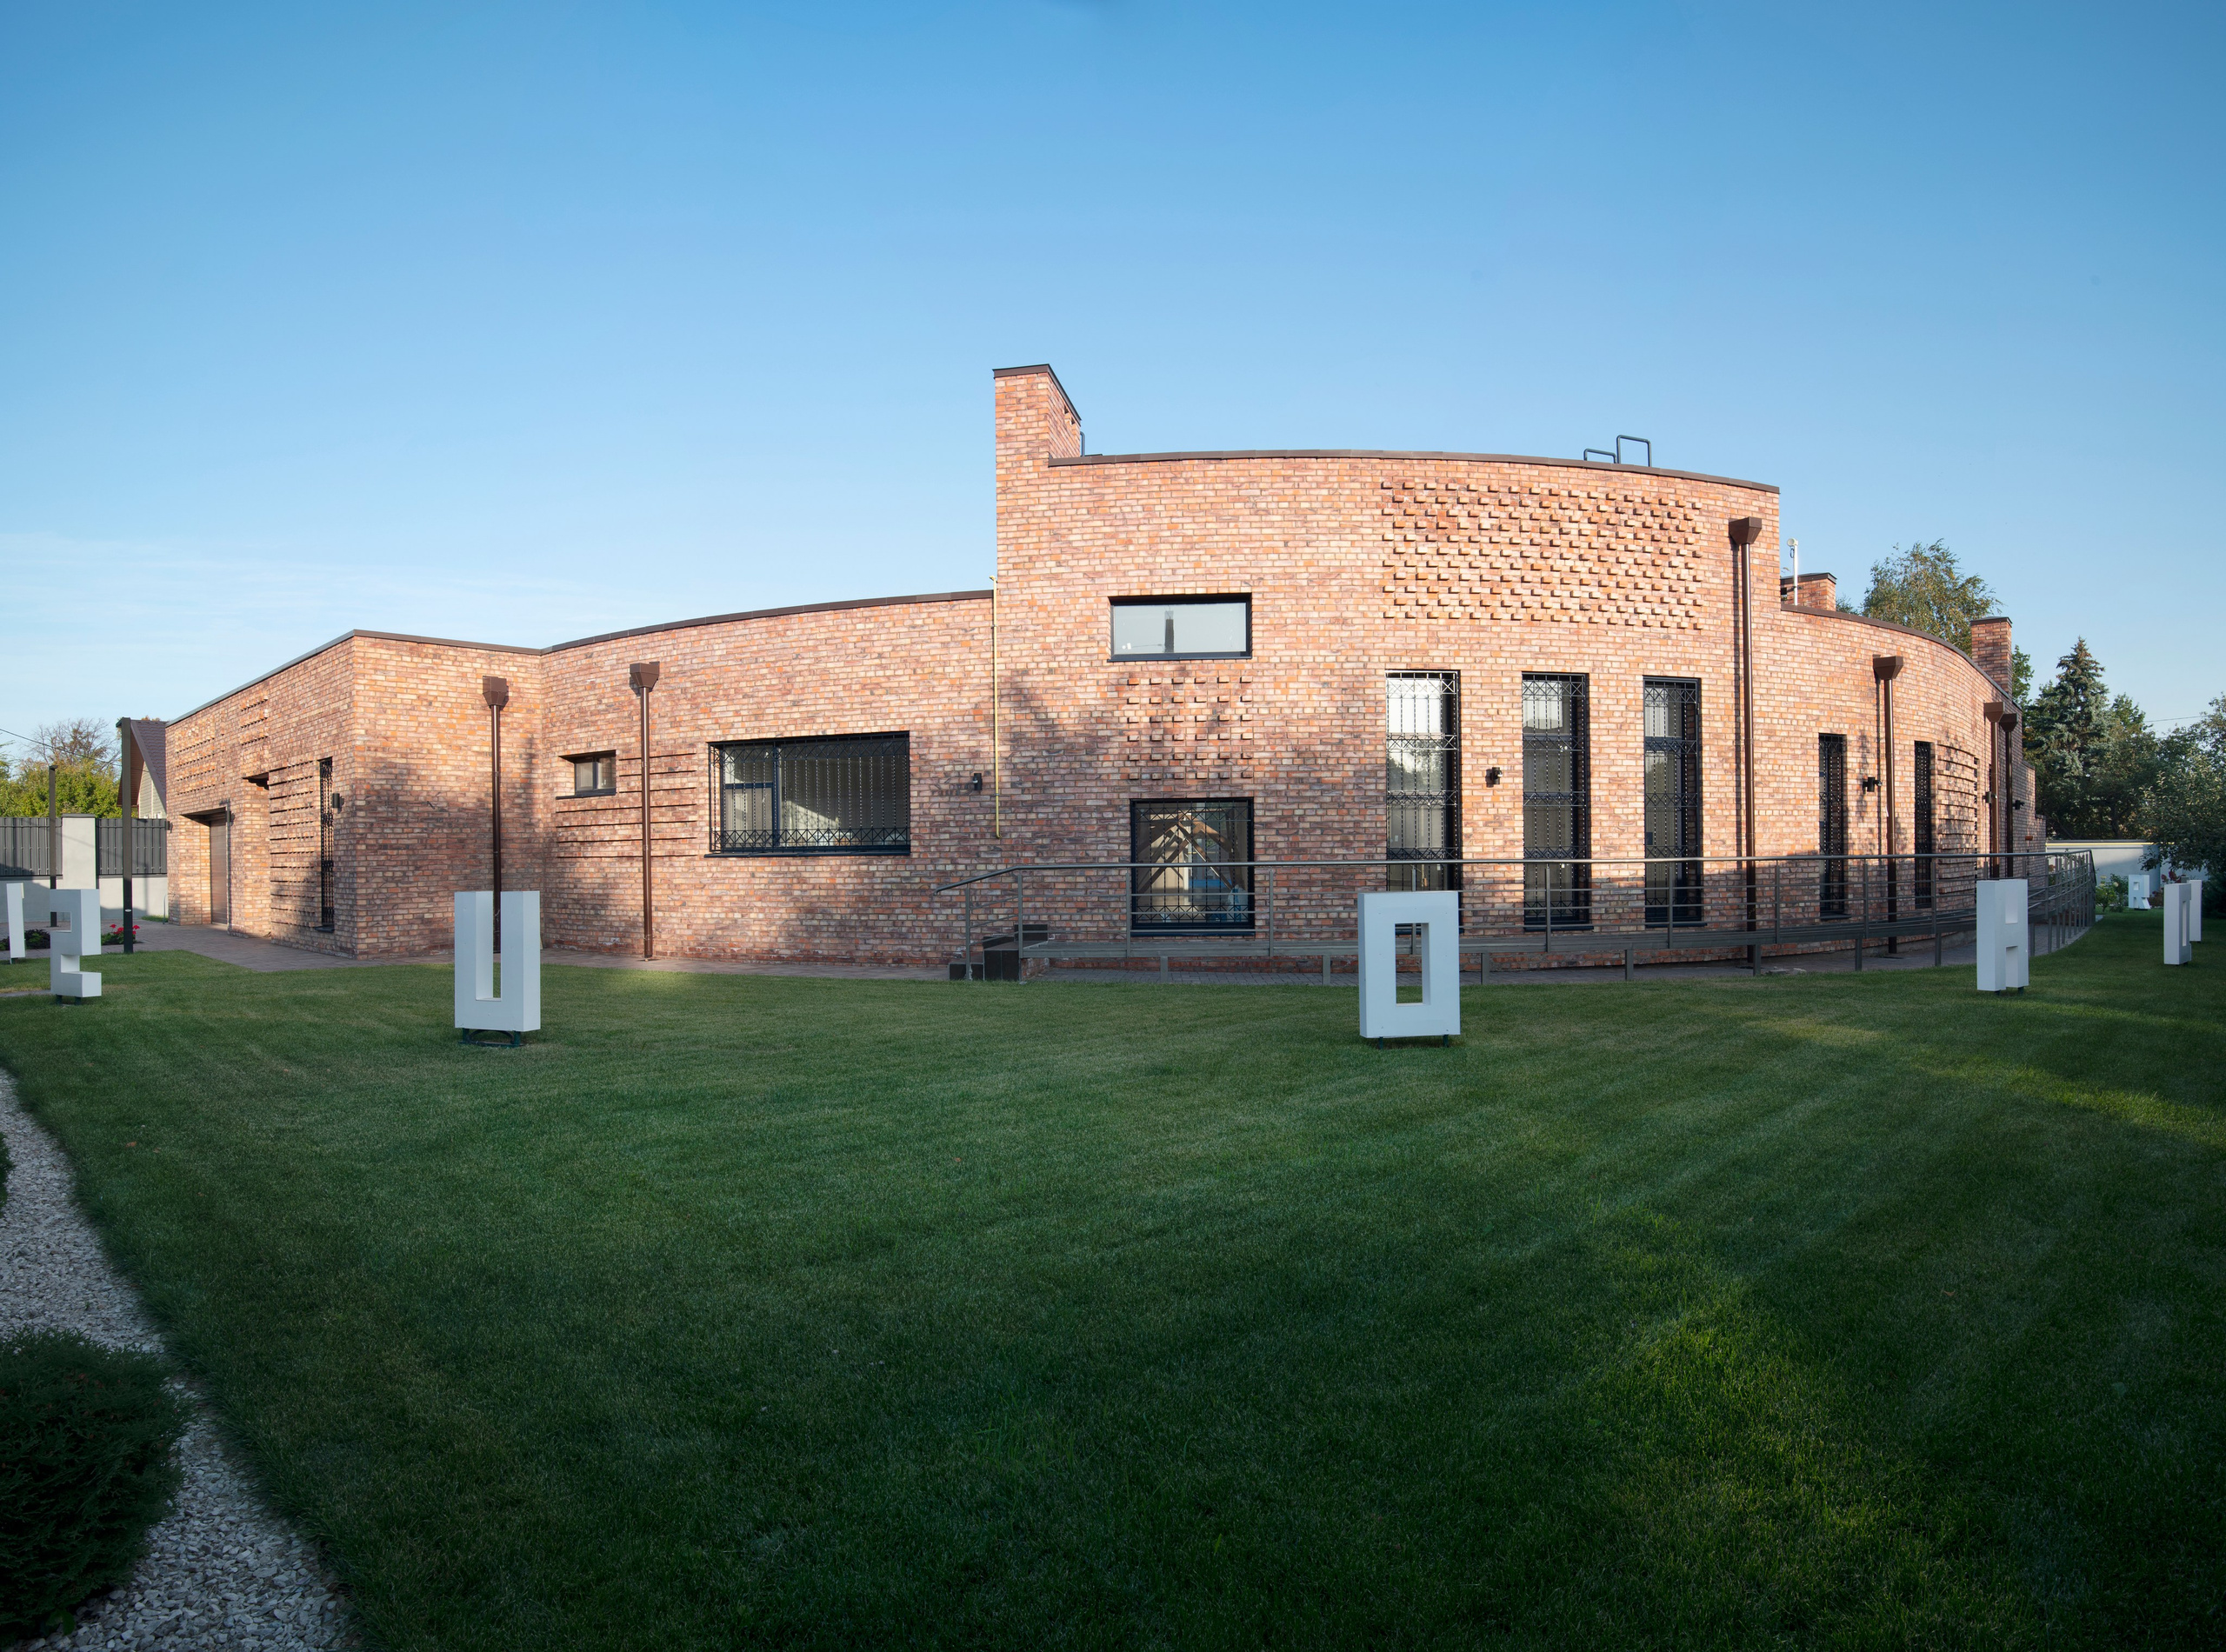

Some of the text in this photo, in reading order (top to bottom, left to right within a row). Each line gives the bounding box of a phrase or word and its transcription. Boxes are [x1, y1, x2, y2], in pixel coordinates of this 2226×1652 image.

[1976, 878, 2029, 991] H
[2129, 875, 2151, 909] R
[454, 890, 541, 1032] U
